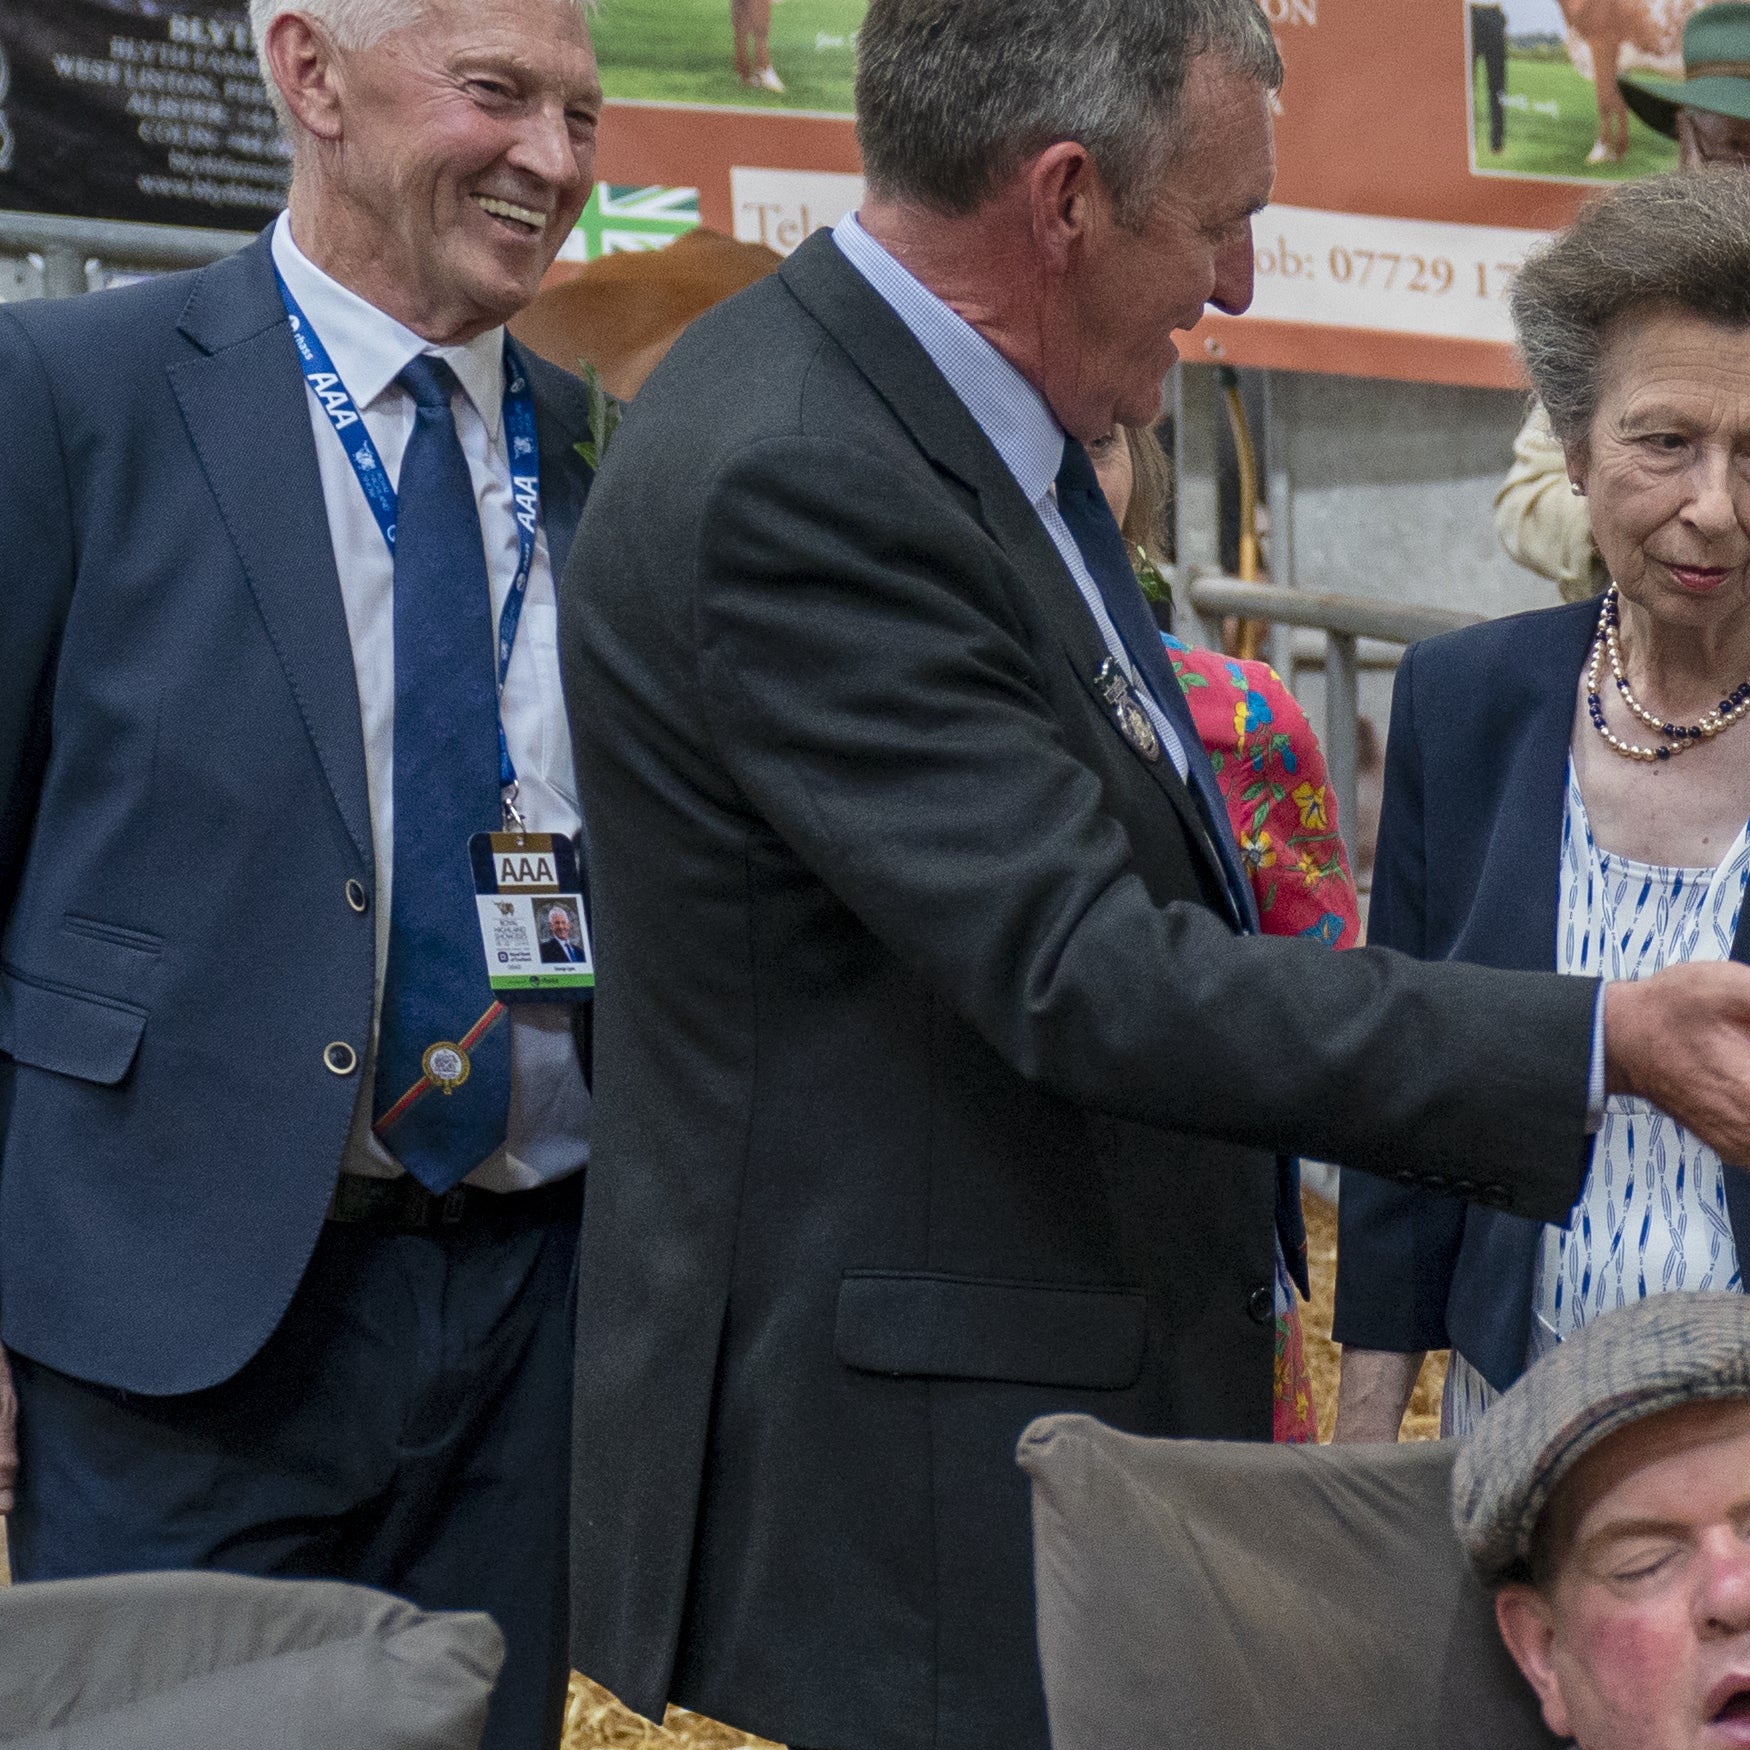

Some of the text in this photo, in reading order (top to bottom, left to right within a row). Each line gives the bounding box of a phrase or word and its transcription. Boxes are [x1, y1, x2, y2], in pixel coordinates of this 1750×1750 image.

[53, 52, 122, 85] WEST
[1328, 245, 1454, 294] 07729
[307, 371, 358, 430] AAA
[513, 476, 538, 533] AAA
[501, 857, 554, 882] AAA
